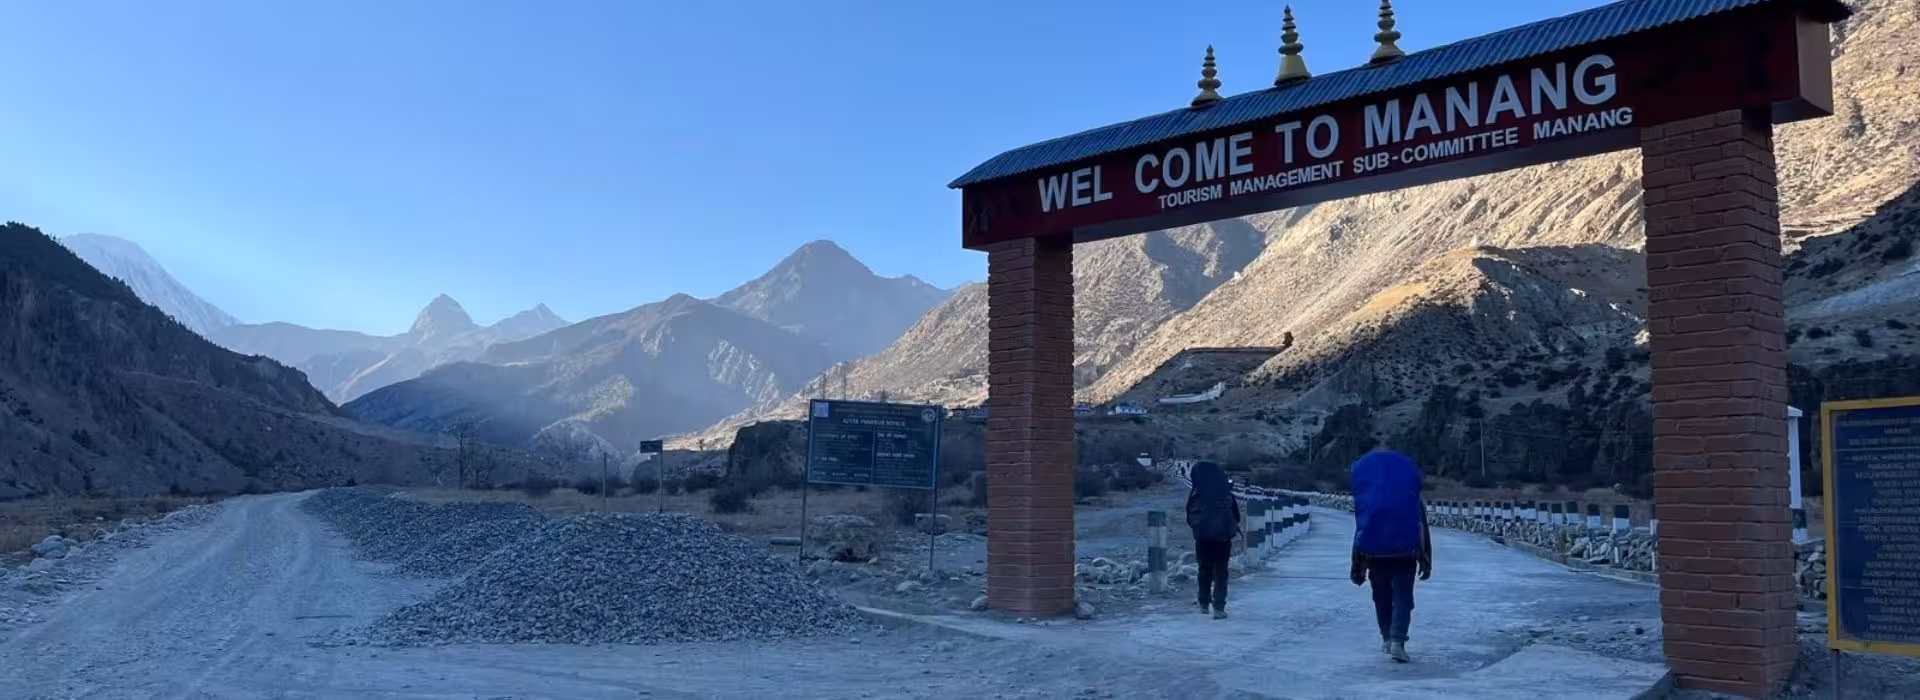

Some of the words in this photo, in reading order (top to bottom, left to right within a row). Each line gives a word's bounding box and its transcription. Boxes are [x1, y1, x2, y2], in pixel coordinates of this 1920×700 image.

[1038, 165, 1113, 212] WEL
[1134, 132, 1253, 193] COME
[1275, 114, 1340, 164] TO
[1364, 55, 1617, 146] MANANG
[1159, 184, 1222, 209] TOURISM
[1230, 161, 1343, 194] MANAGEMENT
[1352, 126, 1519, 174] SUB-COMMITTEE
[1532, 106, 1634, 140] MANANG
